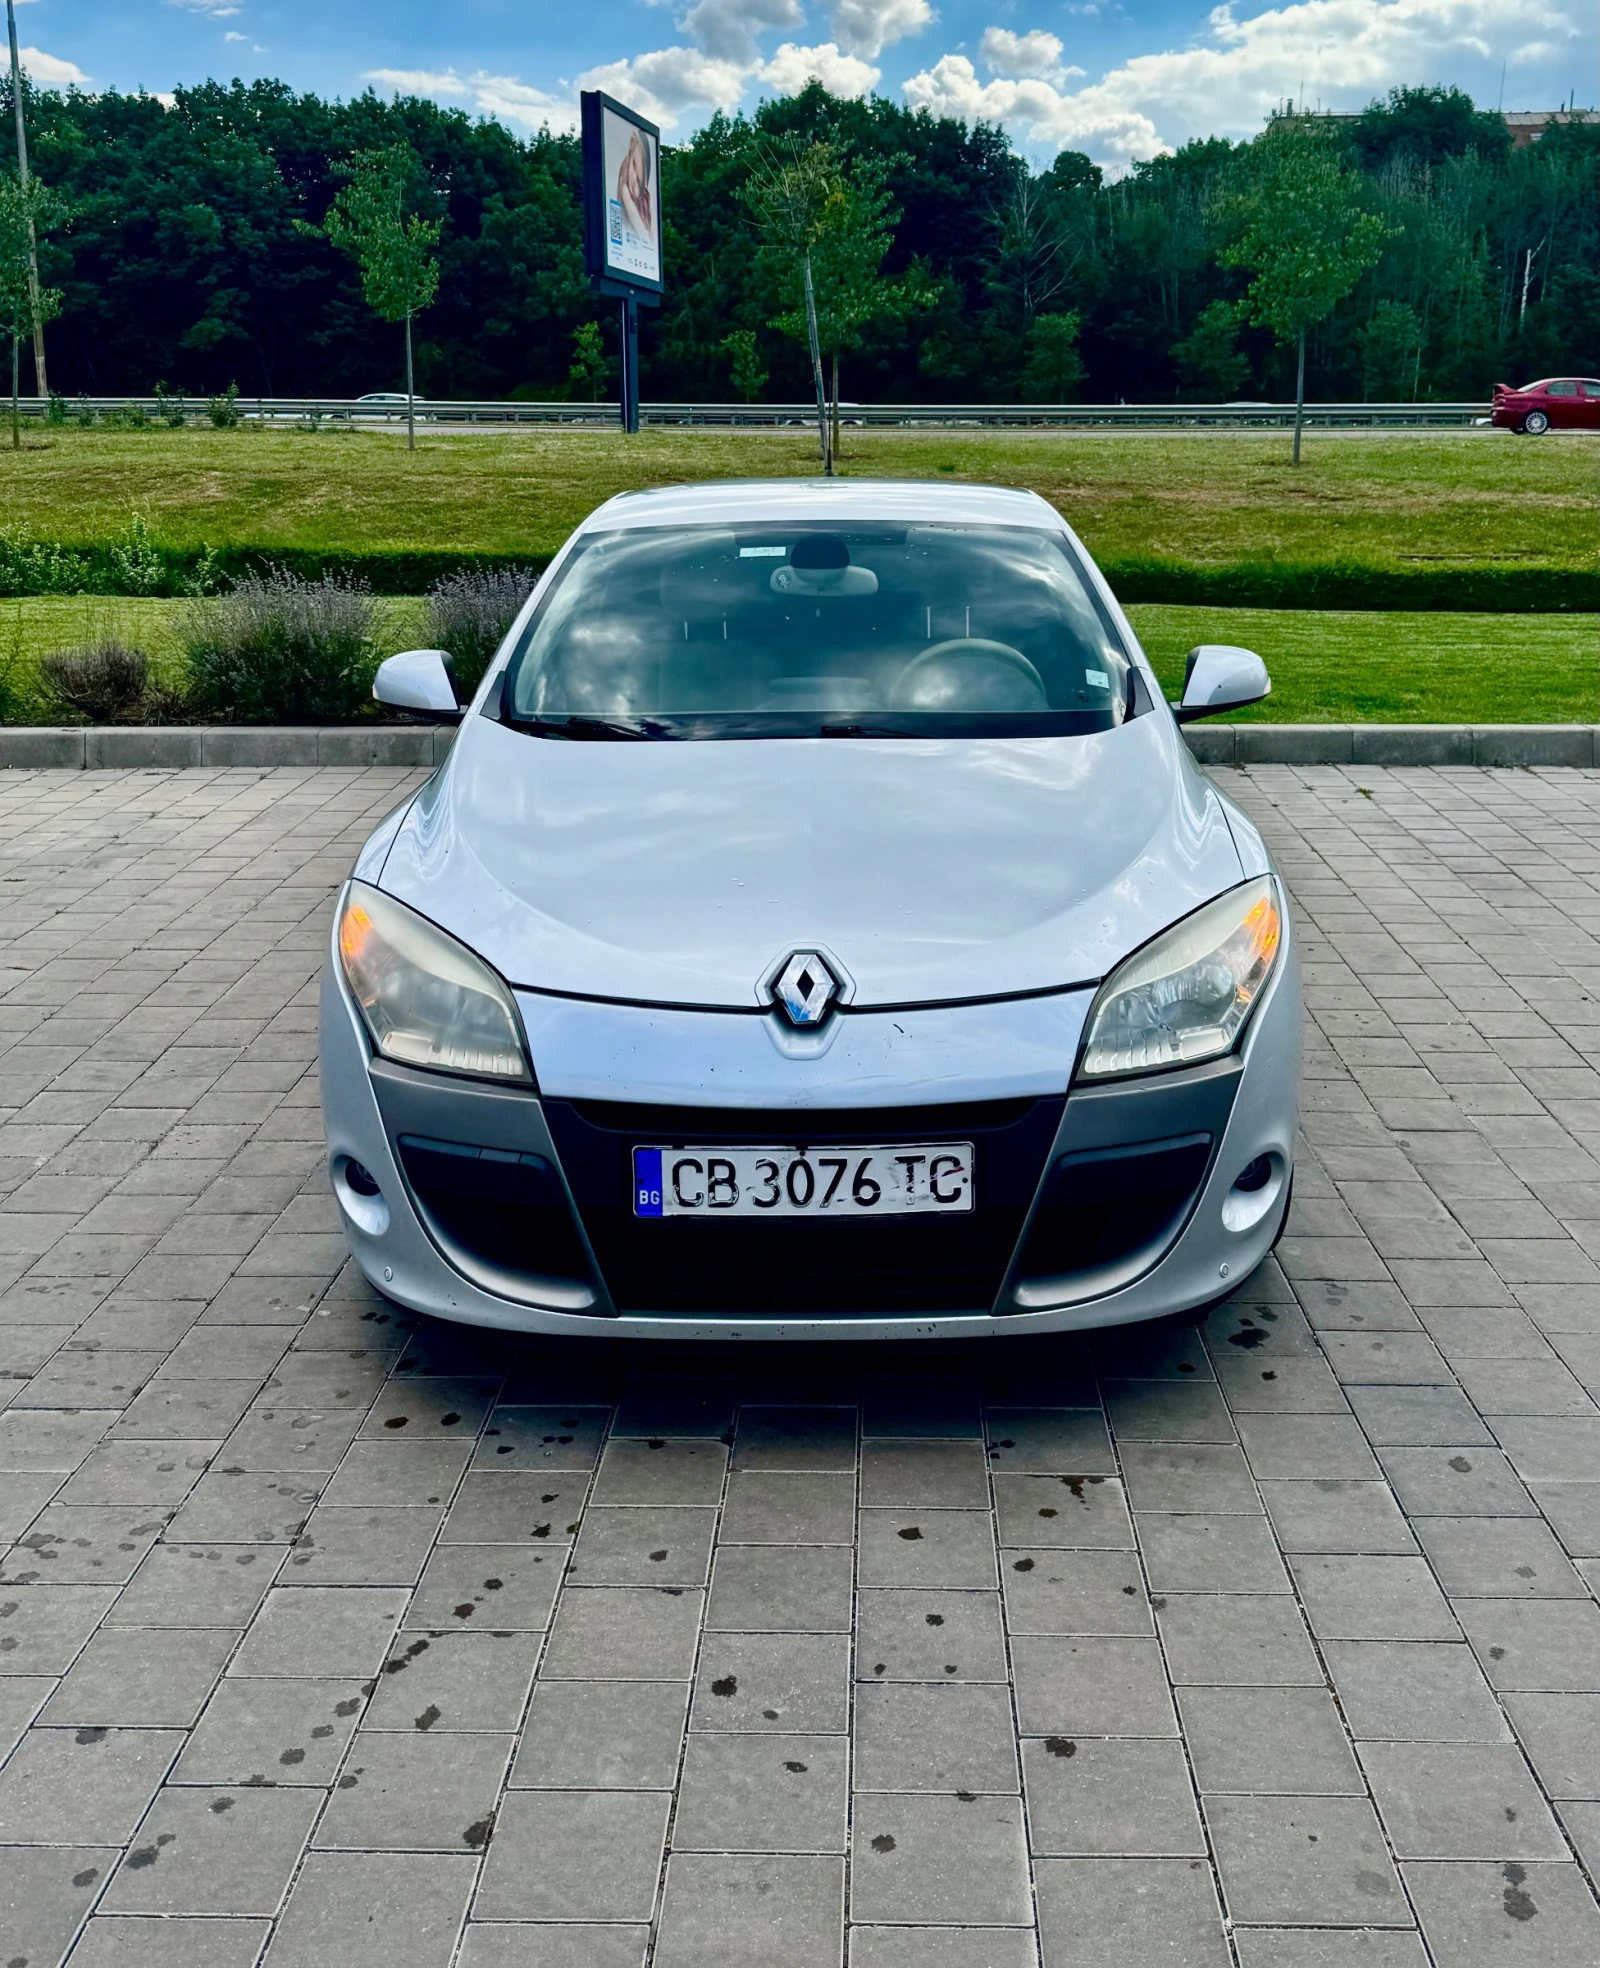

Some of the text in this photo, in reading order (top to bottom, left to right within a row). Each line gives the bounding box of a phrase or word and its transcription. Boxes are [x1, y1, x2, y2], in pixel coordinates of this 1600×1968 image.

[638, 1190, 660, 1205] BG
[672, 1153, 963, 1208] CB 3076 TC
